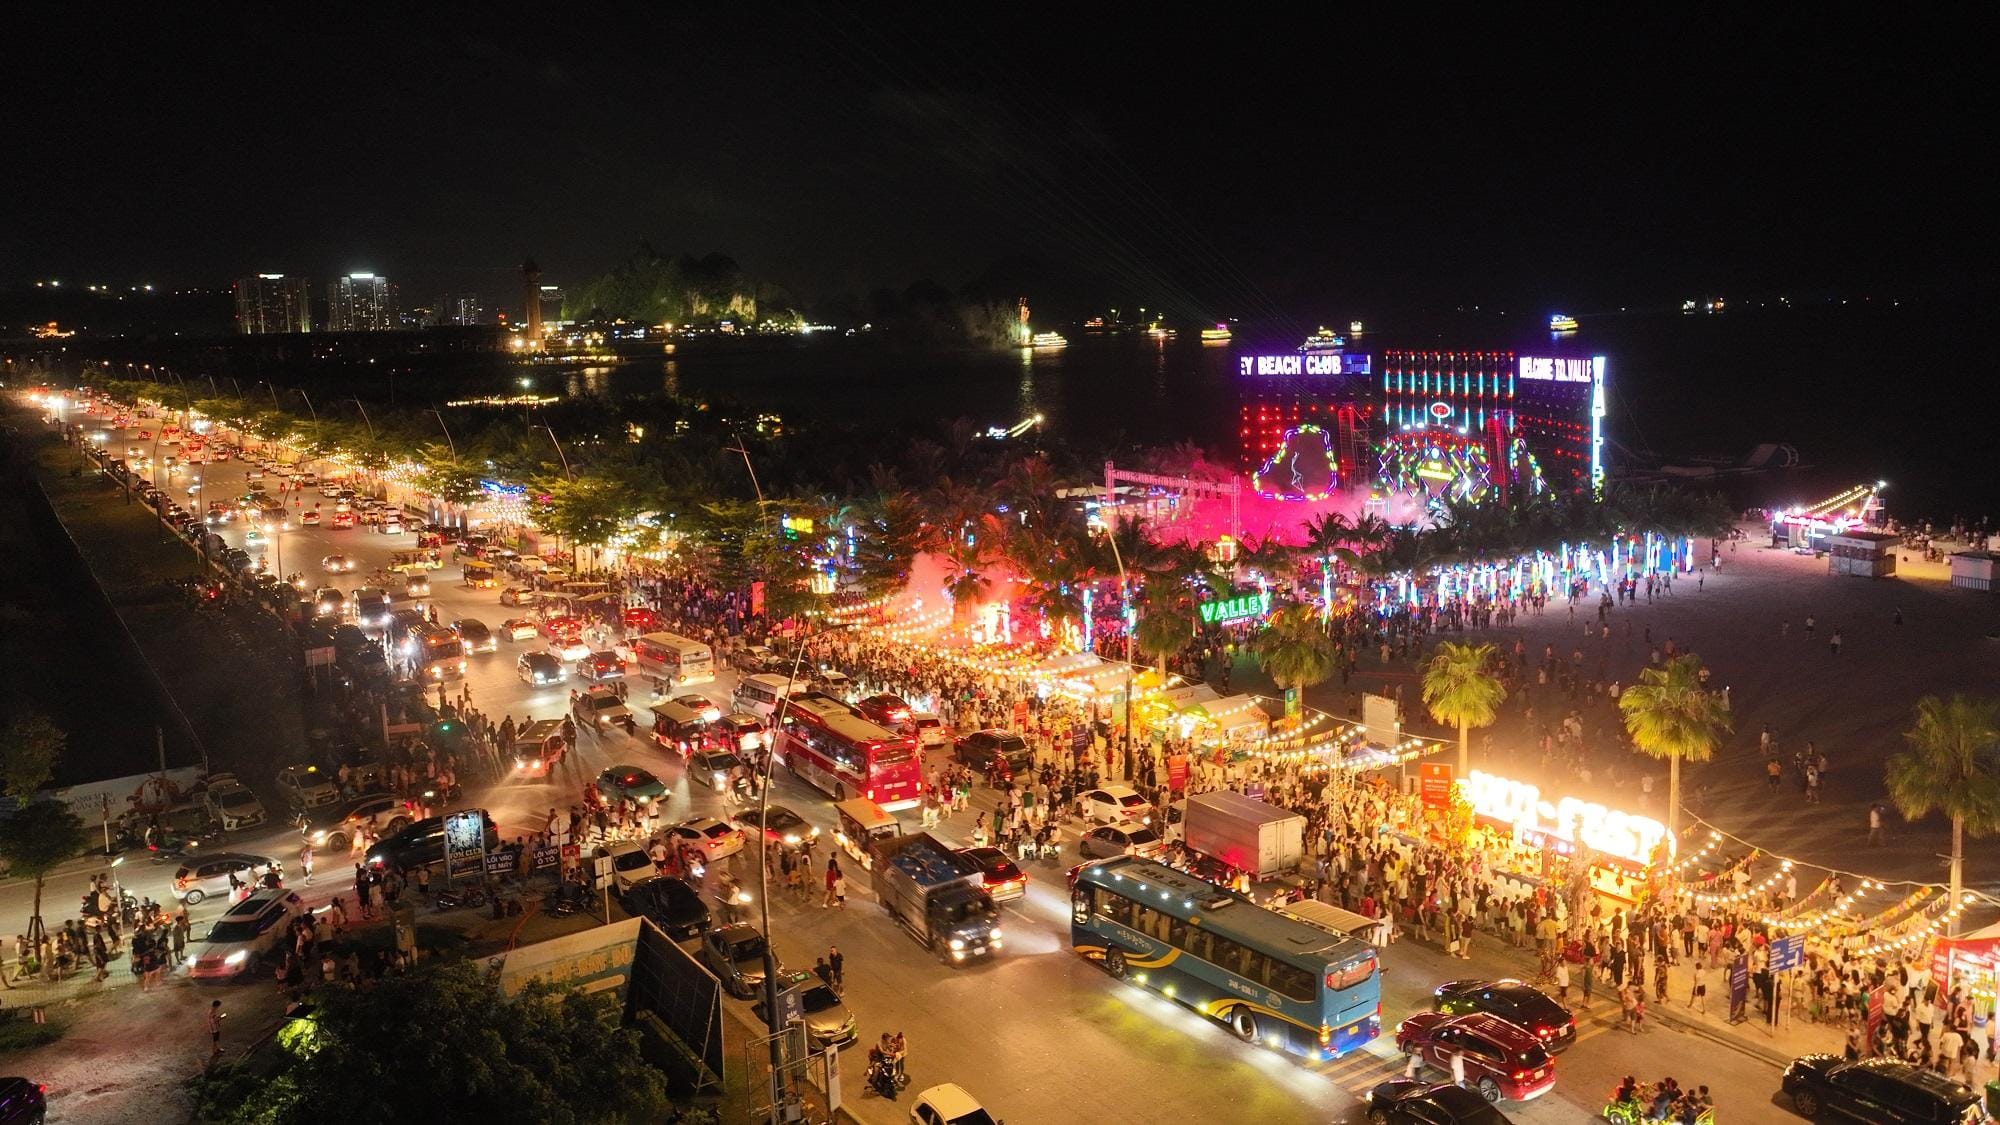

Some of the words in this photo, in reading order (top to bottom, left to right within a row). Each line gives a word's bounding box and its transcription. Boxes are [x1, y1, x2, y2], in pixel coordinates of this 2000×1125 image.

[1258, 356, 1301, 375] BEACH
[1306, 355, 1342, 374] CLUB
[1200, 592, 1272, 623] VALLEY
